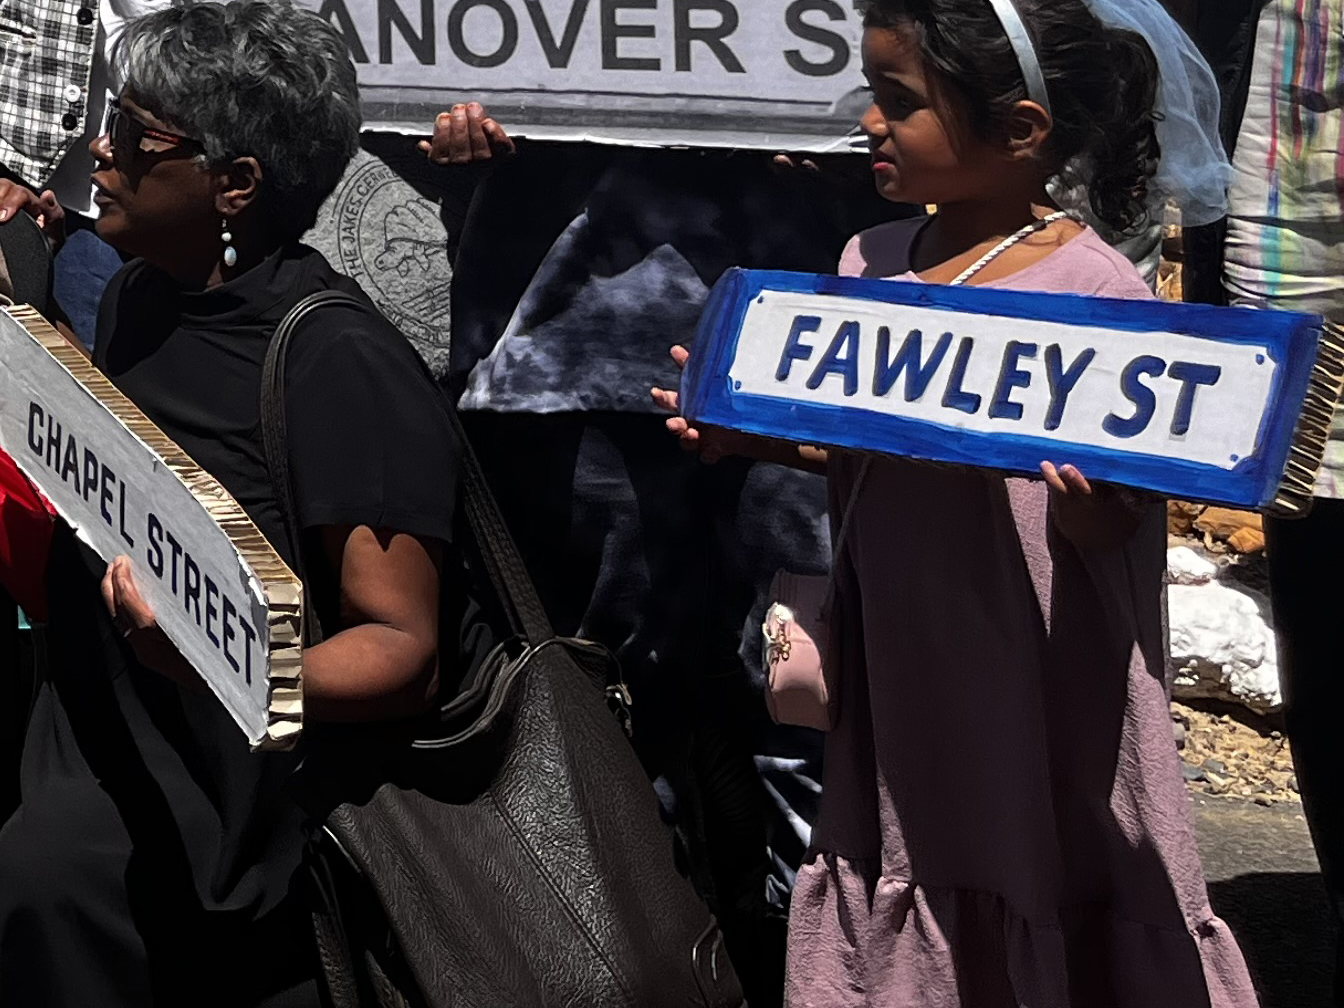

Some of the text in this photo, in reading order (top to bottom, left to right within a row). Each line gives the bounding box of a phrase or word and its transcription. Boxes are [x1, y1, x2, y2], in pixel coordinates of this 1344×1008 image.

[341, 196, 363, 244] JAKES
[343, 248, 366, 278] THE
[775, 314, 1222, 440] FAWLEY ST
[27, 401, 257, 688] CHAPEL STREET
